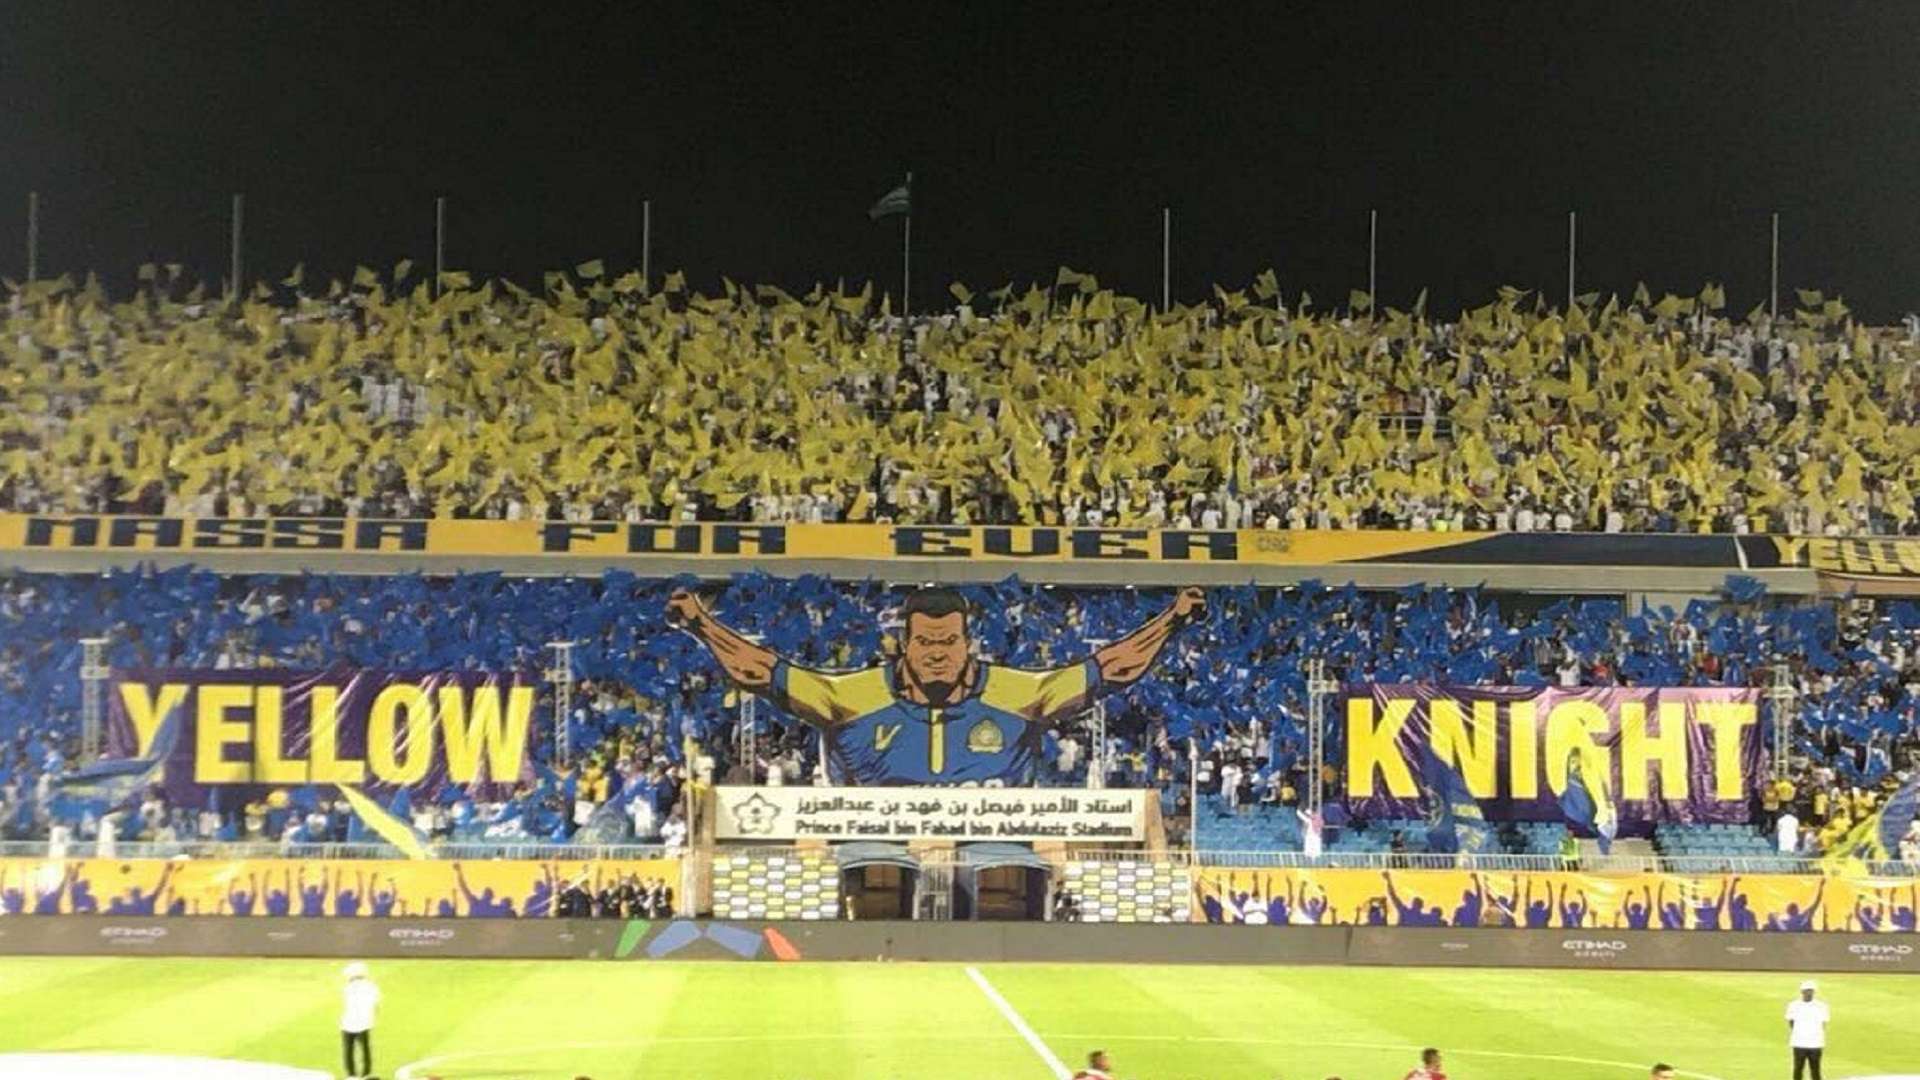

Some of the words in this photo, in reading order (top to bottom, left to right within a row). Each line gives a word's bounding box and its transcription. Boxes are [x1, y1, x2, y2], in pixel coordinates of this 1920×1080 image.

[119, 683, 535, 784] YELLOW
[1347, 697, 1758, 800] KNIGHT
[795, 819, 843, 835] Prince
[846, 819, 890, 835] Faisal
[895, 819, 917, 835] bin
[921, 820, 966, 836] Fahad
[969, 820, 993, 836] bin
[996, 821, 1068, 837] Abdulaziz
[1071, 821, 1133, 837] Stadium
[905, 798, 943, 816] فهد
